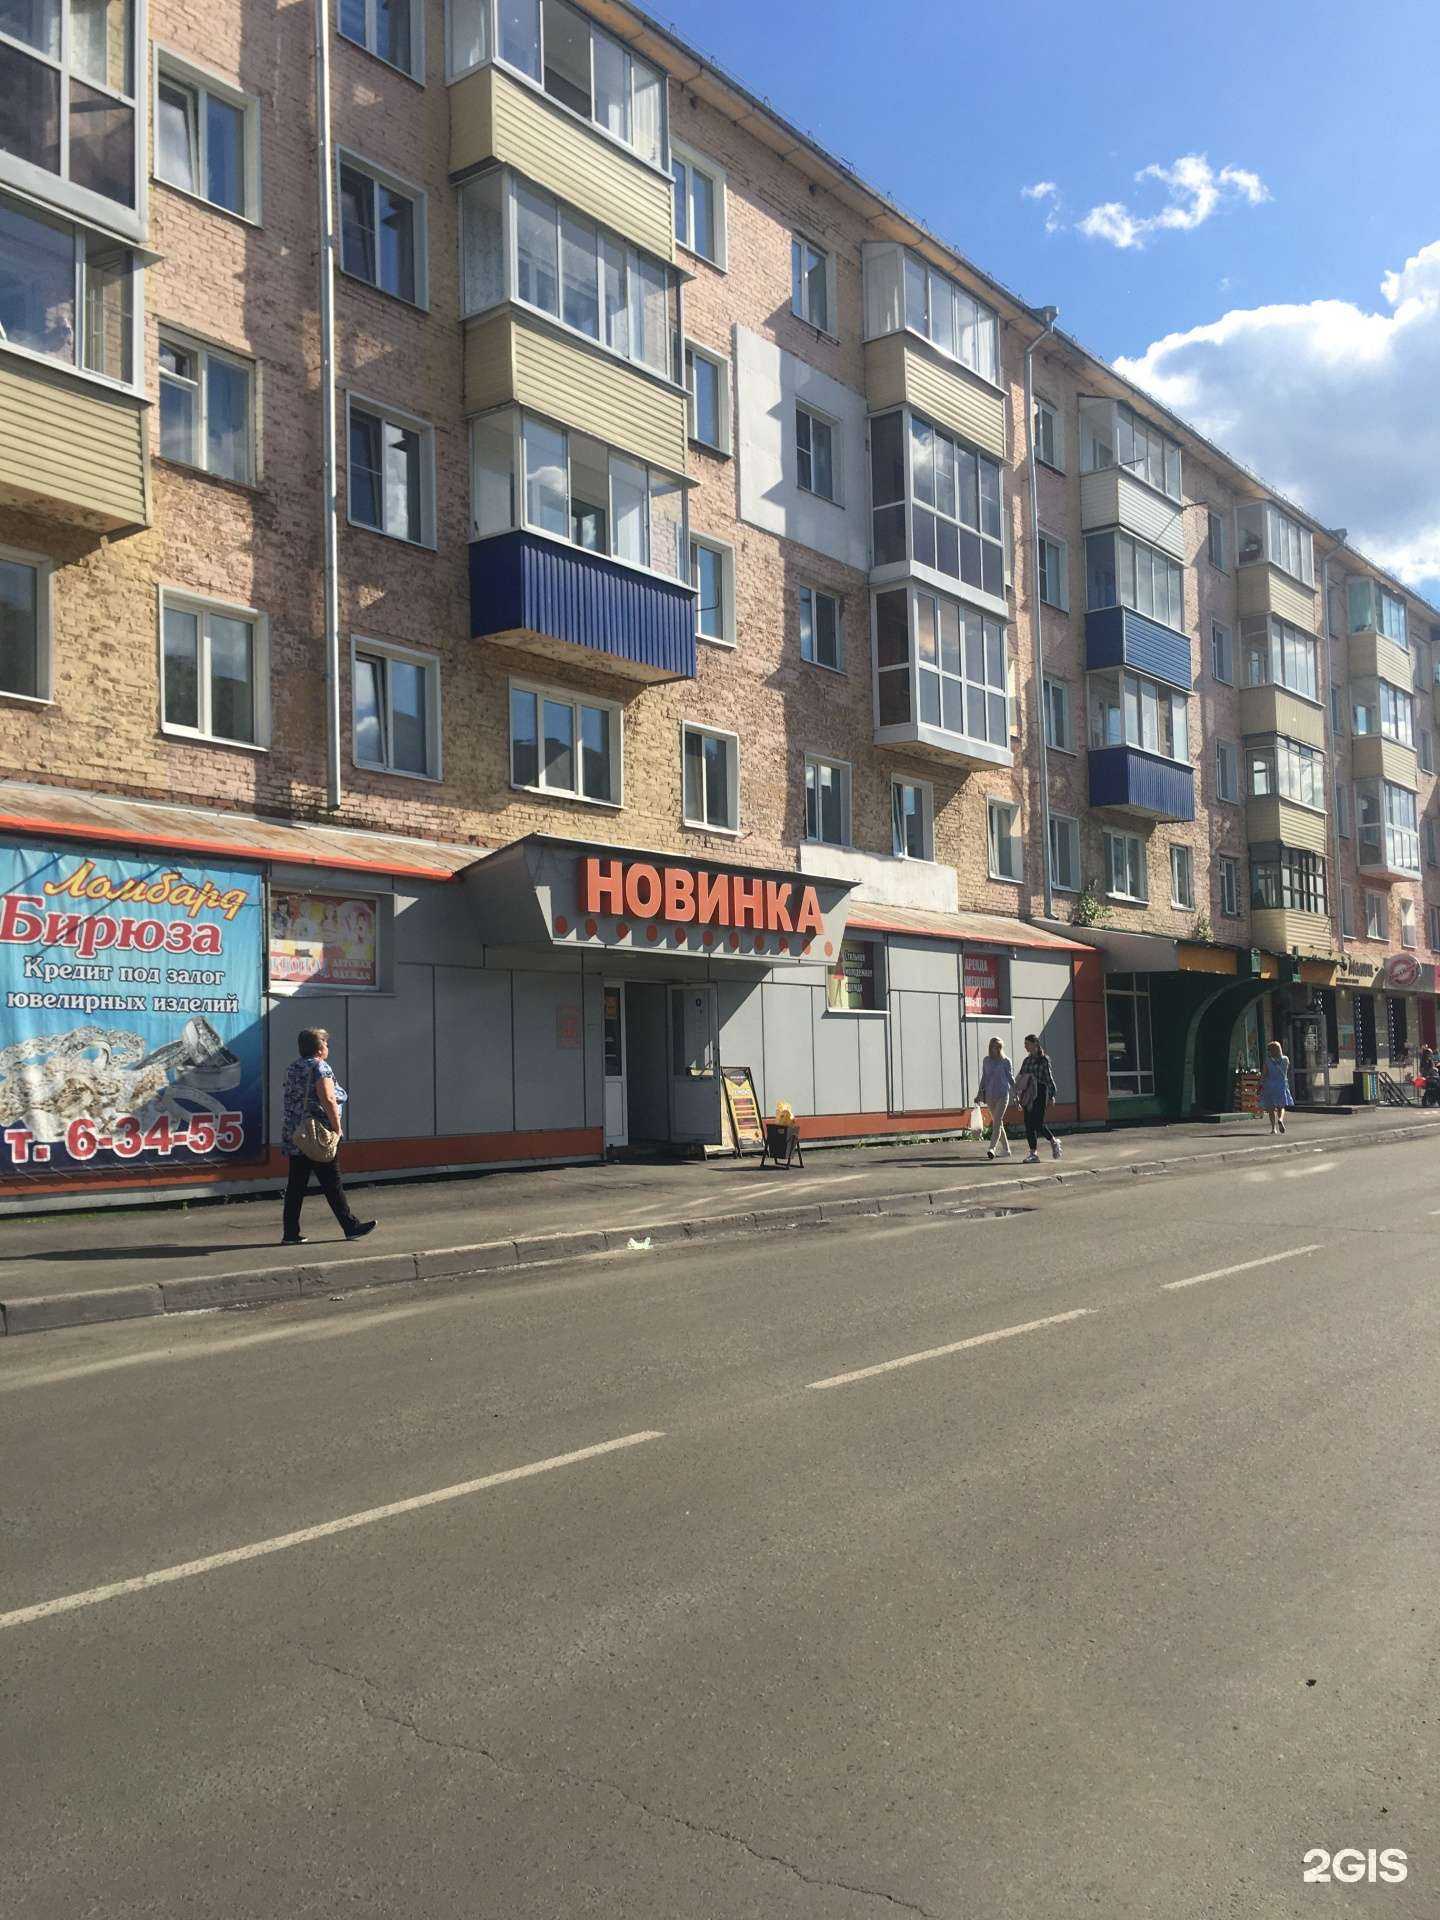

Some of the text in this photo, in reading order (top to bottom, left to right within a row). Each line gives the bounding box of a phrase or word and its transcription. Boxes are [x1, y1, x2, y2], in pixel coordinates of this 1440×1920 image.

[43, 858, 248, 920] Ломбард
[580, 857, 825, 935] НОВИНКА
[0, 894, 223, 958] Бирюза
[24, 956, 225, 985] Кредит под залог
[7, 992, 239, 1013] ювелирных изделий
[66, 1111, 244, 1160] 6-34-55
